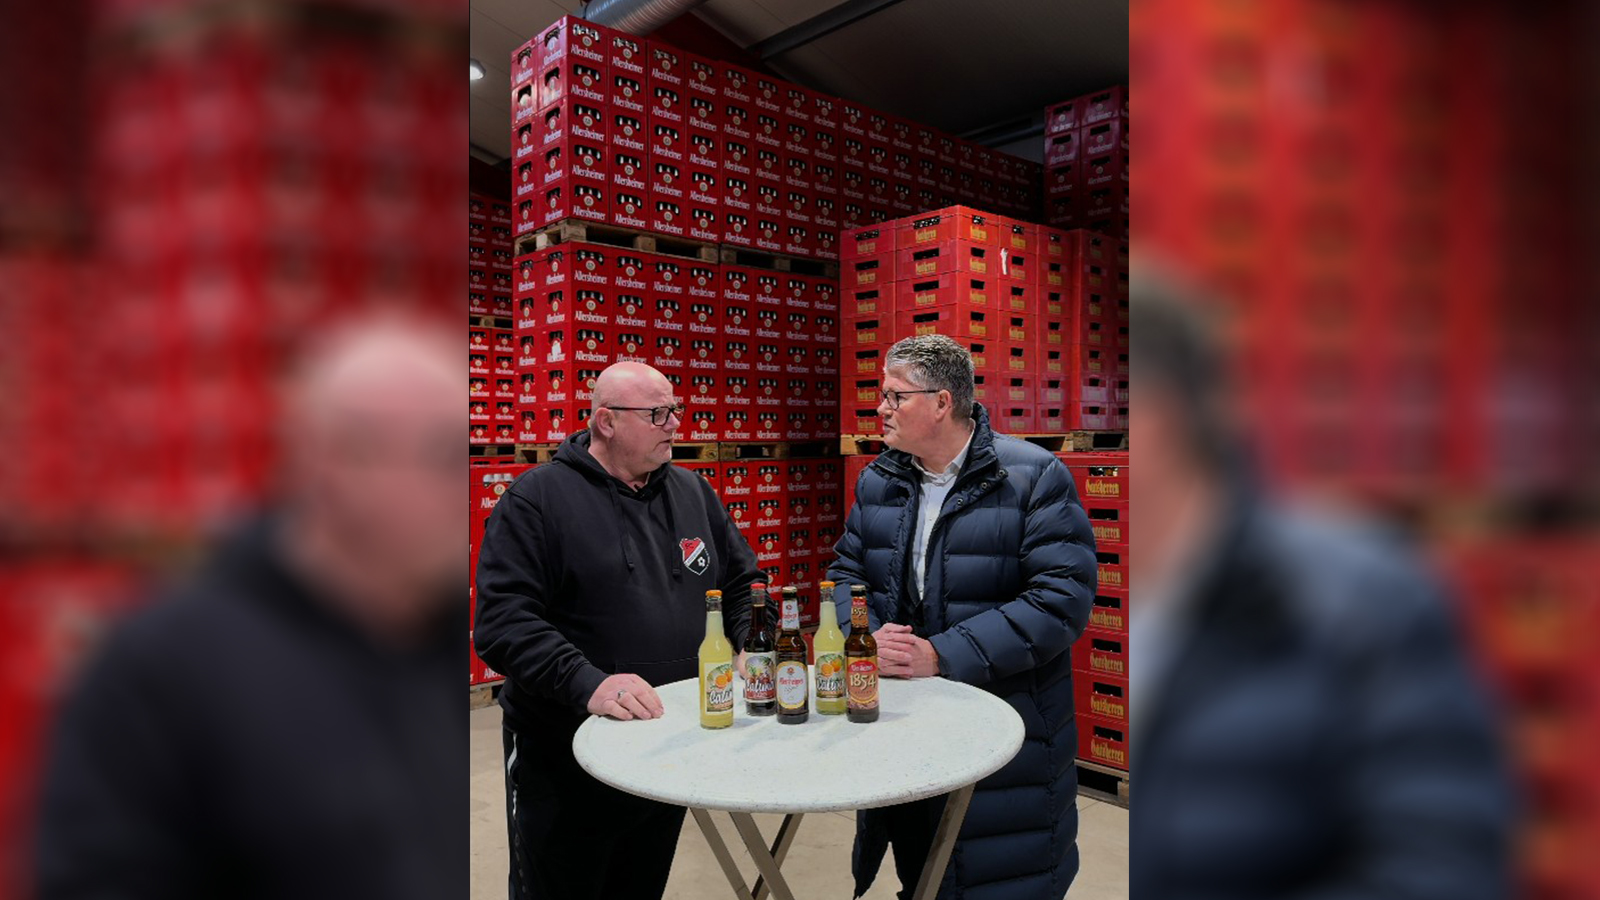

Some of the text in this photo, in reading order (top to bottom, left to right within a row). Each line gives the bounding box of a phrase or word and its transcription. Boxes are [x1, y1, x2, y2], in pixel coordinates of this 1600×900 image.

[571, 44, 604, 62] Allersheimer
[612, 56, 643, 74] Allersheimer
[572, 85, 604, 102] Allersheimer
[613, 95, 644, 112] Allersheimer
[572, 125, 604, 141] Allersheimer
[614, 134, 644, 151] Allersheimer
[572, 165, 605, 181] Allersheimer
[614, 173, 645, 189] Allersheimer
[573, 205, 606, 220] Allersheimer
[615, 212, 646, 228] Allersheimer
[574, 270, 607, 284] Allersheimer
[615, 276, 646, 290] Allersheimer
[574, 311, 608, 323] Allersheimer
[615, 315, 646, 327] Allersheimer
[575, 351, 608, 363] Allersheimer
[850, 673, 876, 690] 1854
